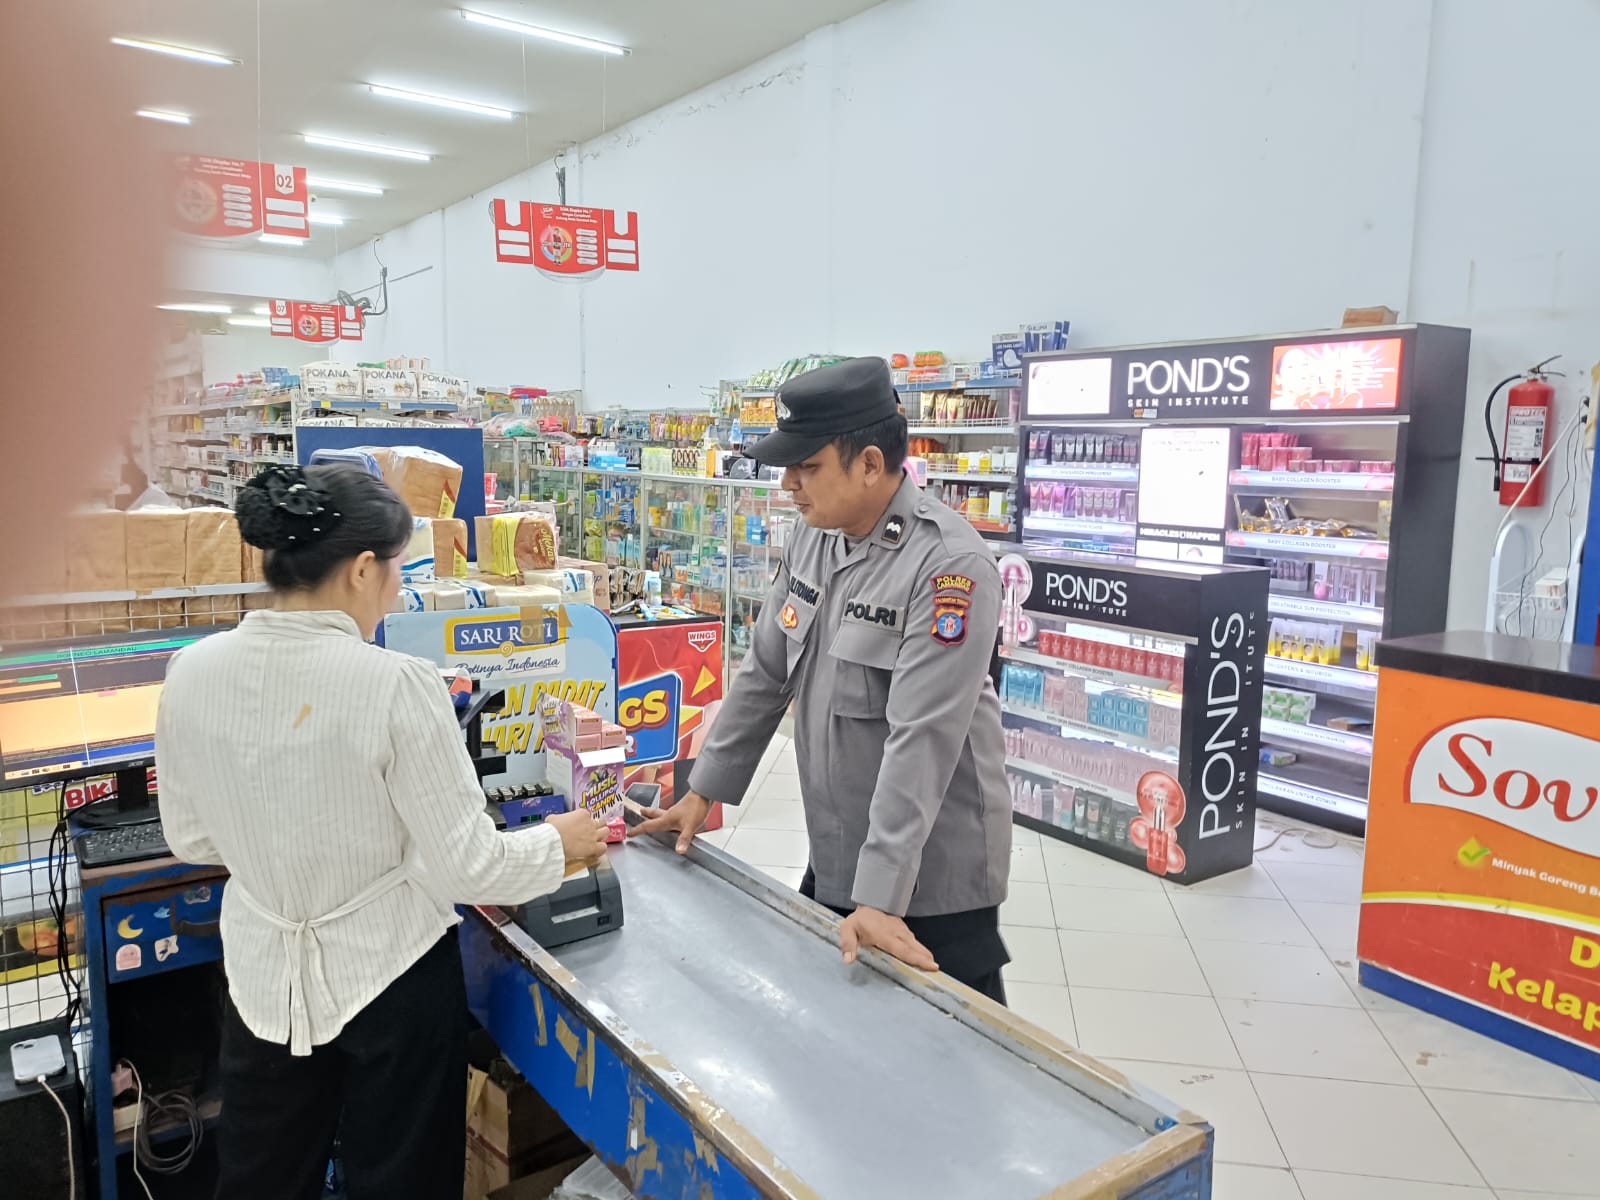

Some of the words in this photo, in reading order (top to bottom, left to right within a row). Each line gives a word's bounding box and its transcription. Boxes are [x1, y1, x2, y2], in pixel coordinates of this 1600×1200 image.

[276, 174, 293, 189] 02
[306, 368, 350, 378] POKANA
[366, 371, 407, 380] POKANA
[422, 373, 461, 387] POKANA
[1127, 355, 1250, 395] POND'S
[1127, 398, 1159, 408] SKIN
[1168, 395, 1249, 407] INSTITUTE
[1186, 531, 1220, 542] HAPPEN
[936, 575, 972, 587] POLRES
[1046, 572, 1127, 607] POND'S
[845, 601, 896, 626] POLRI
[1048, 598, 1067, 608] KIN
[1073, 602, 1127, 617] INSTUTE
[461, 627, 502, 645] SARI
[510, 623, 553, 643] ROTI
[688, 631, 716, 640] WINGS
[504, 656, 560, 672] Indonesia
[619, 690, 669, 731] GS
[1199, 612, 1244, 839] POND'S
[580, 772, 617, 808] MUSIC
[591, 793, 616, 812] CANDY
[1235, 771, 1246, 829] SKIN
[1492, 857, 1536, 878] Minyak
[1539, 871, 1586, 894] Goreng
